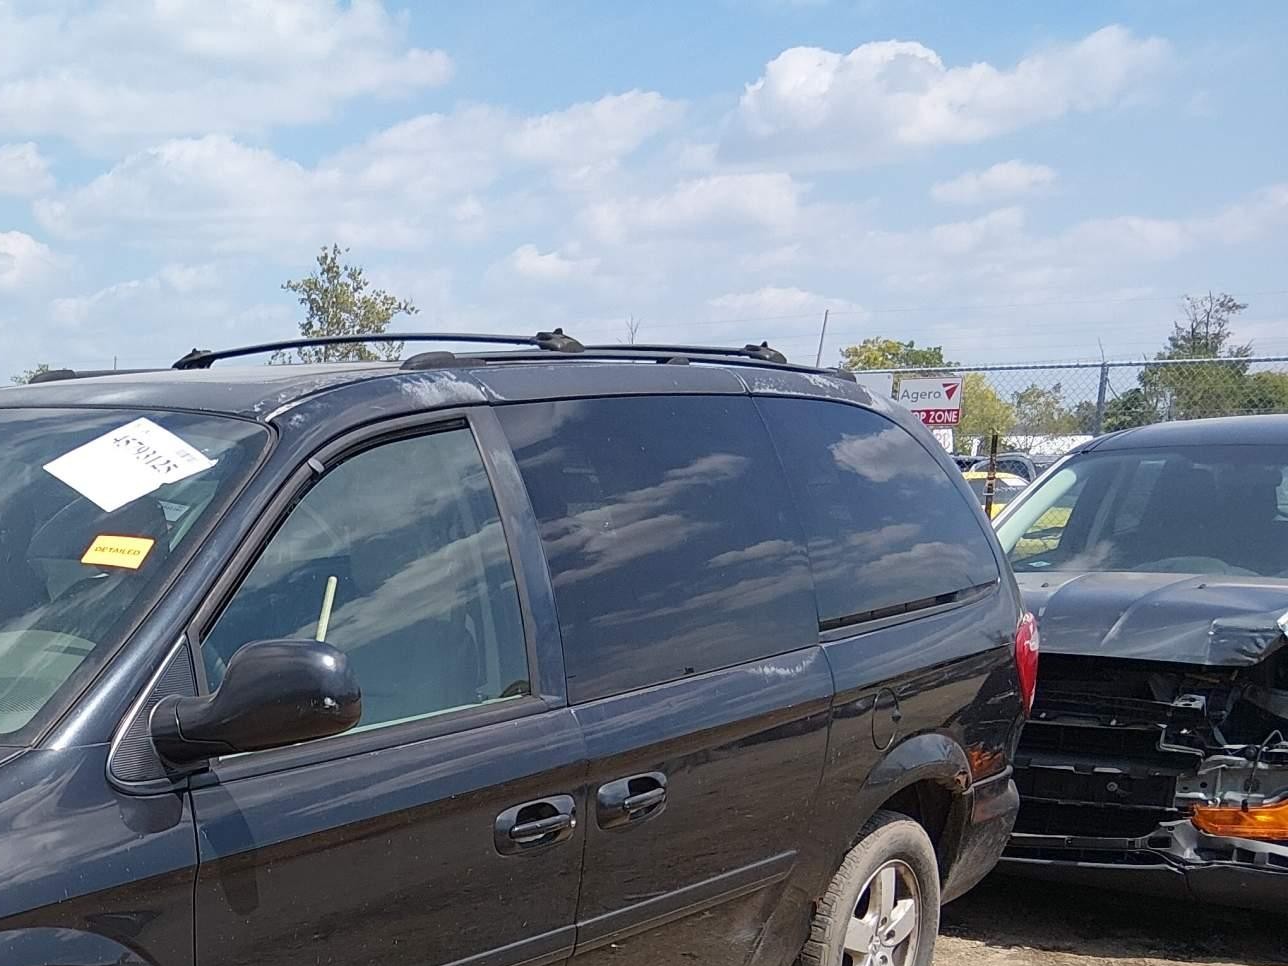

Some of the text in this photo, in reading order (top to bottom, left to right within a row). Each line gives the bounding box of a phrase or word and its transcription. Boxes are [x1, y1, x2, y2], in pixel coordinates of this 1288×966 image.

[900, 389, 942, 403] Agero
[928, 410, 958, 423] ZONE
[93, 545, 141, 556] DETAILED
